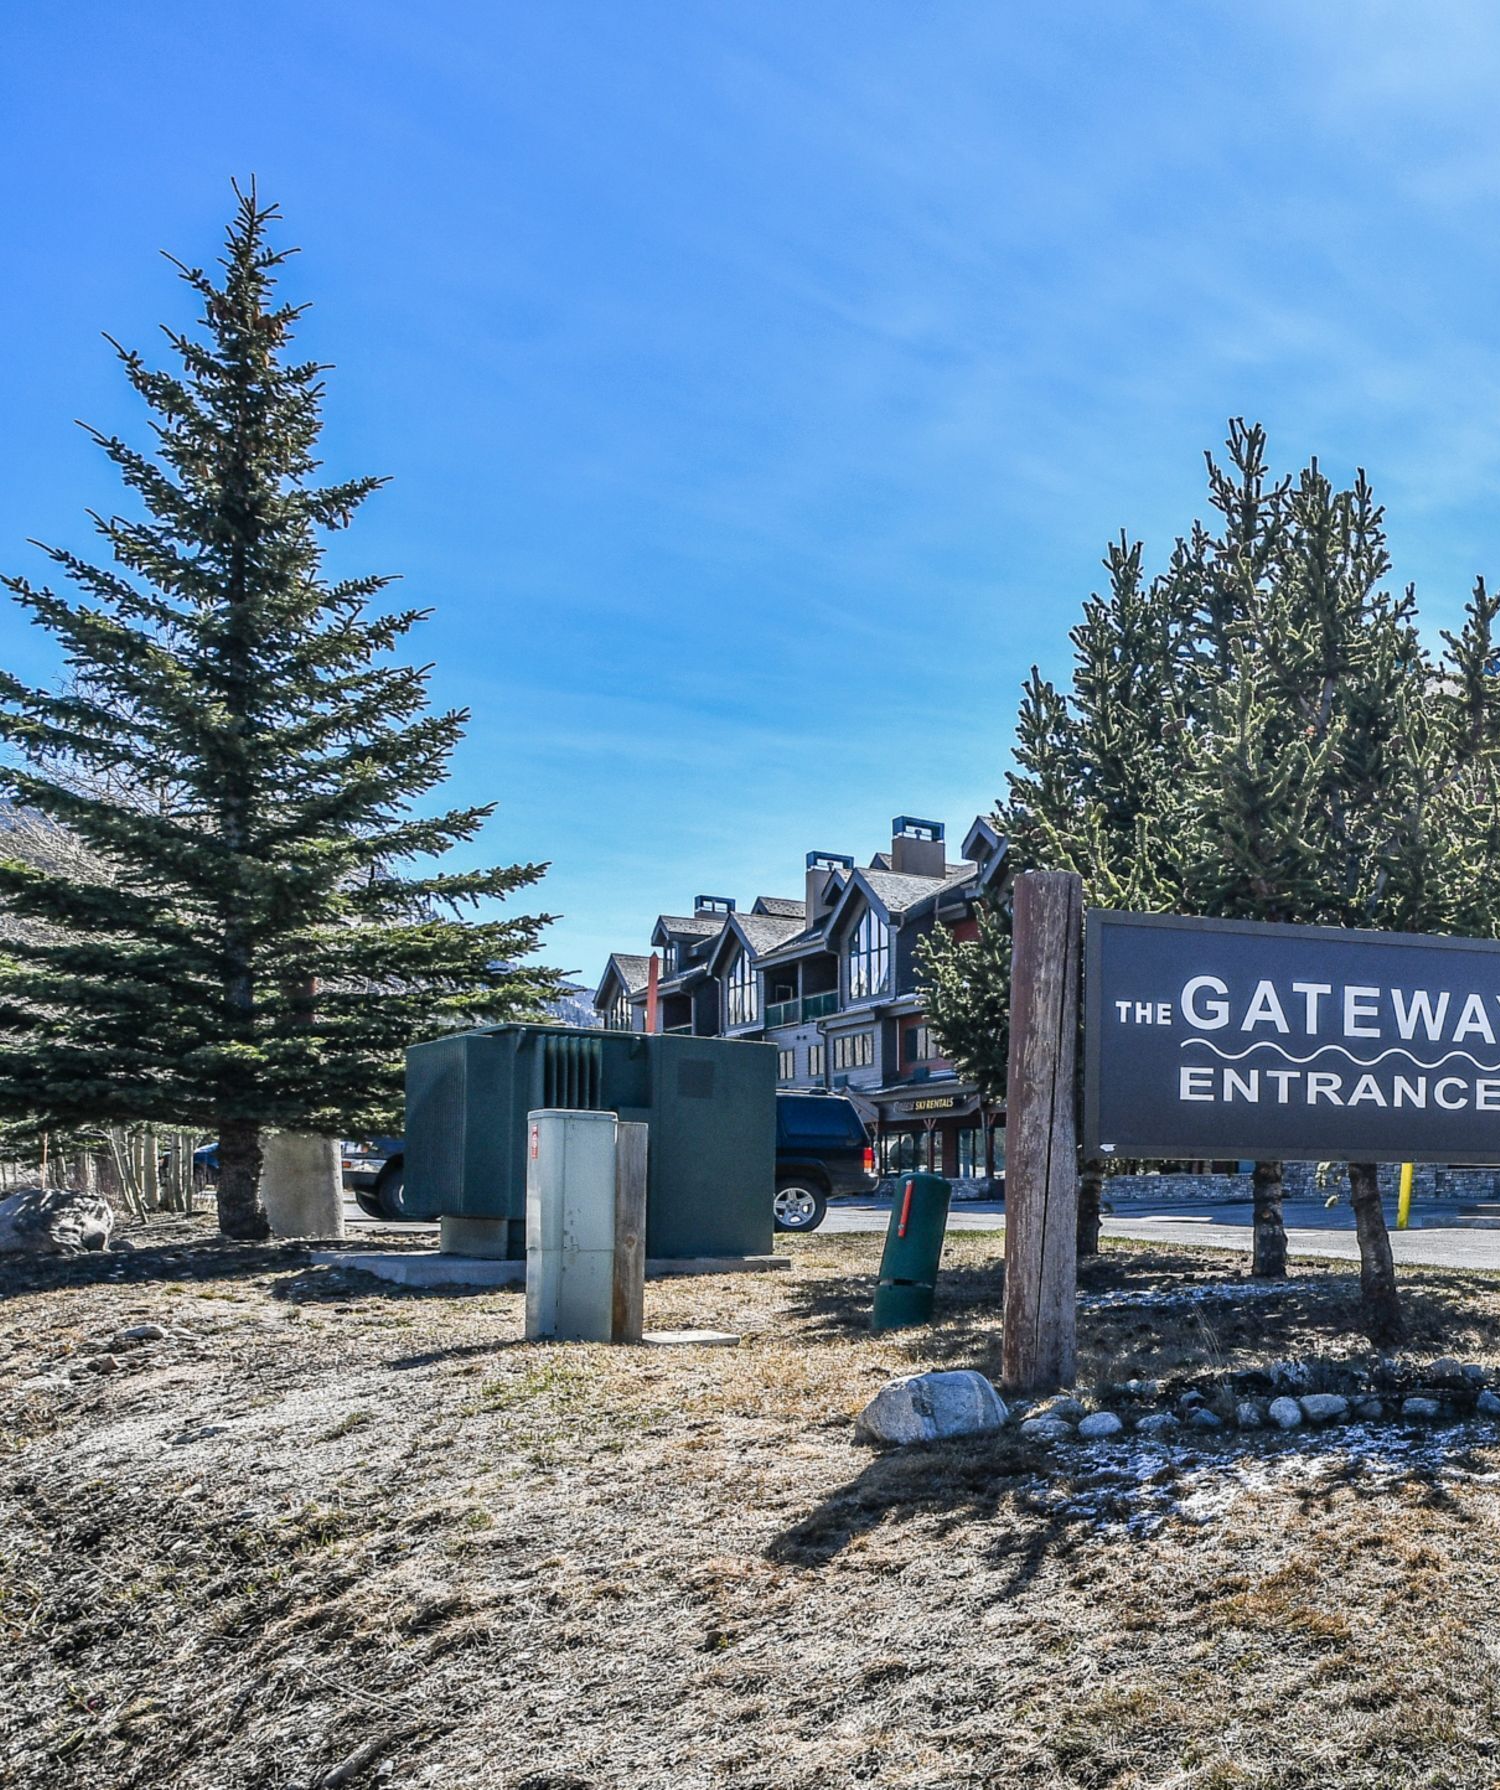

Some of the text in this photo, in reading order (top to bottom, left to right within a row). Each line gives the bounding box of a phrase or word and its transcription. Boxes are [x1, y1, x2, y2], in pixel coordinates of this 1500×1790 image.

[1115, 1000, 1172, 1026] THE
[915, 1100, 926, 1111] SKI
[926, 1097, 954, 1109] RENTALS
